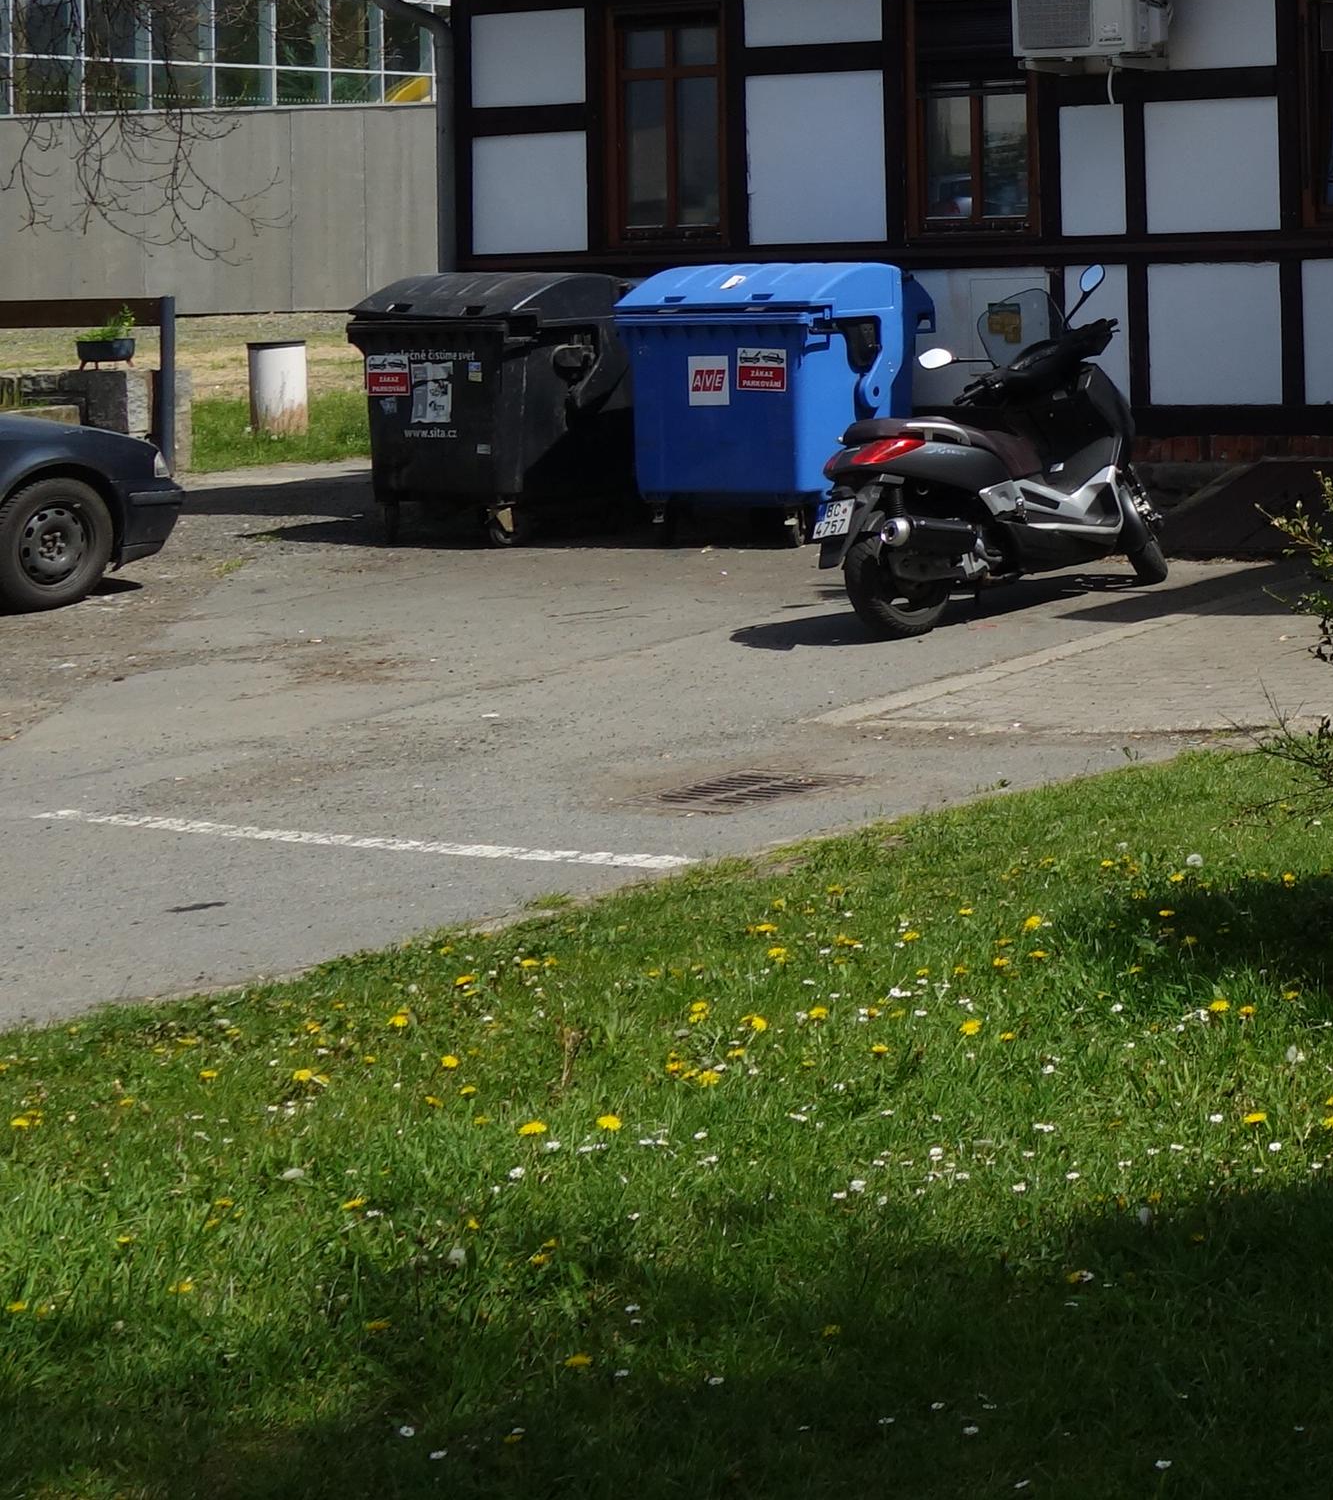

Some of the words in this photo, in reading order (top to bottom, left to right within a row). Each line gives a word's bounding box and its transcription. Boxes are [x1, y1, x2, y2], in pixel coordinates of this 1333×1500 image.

[750, 369, 774, 377] ZÁKAZ
[693, 374, 724, 388] AVE
[742, 379, 782, 388] PARKOVÁNÍ
[403, 427, 457, 438] www.sita.cz
[816, 518, 846, 536] 4757
